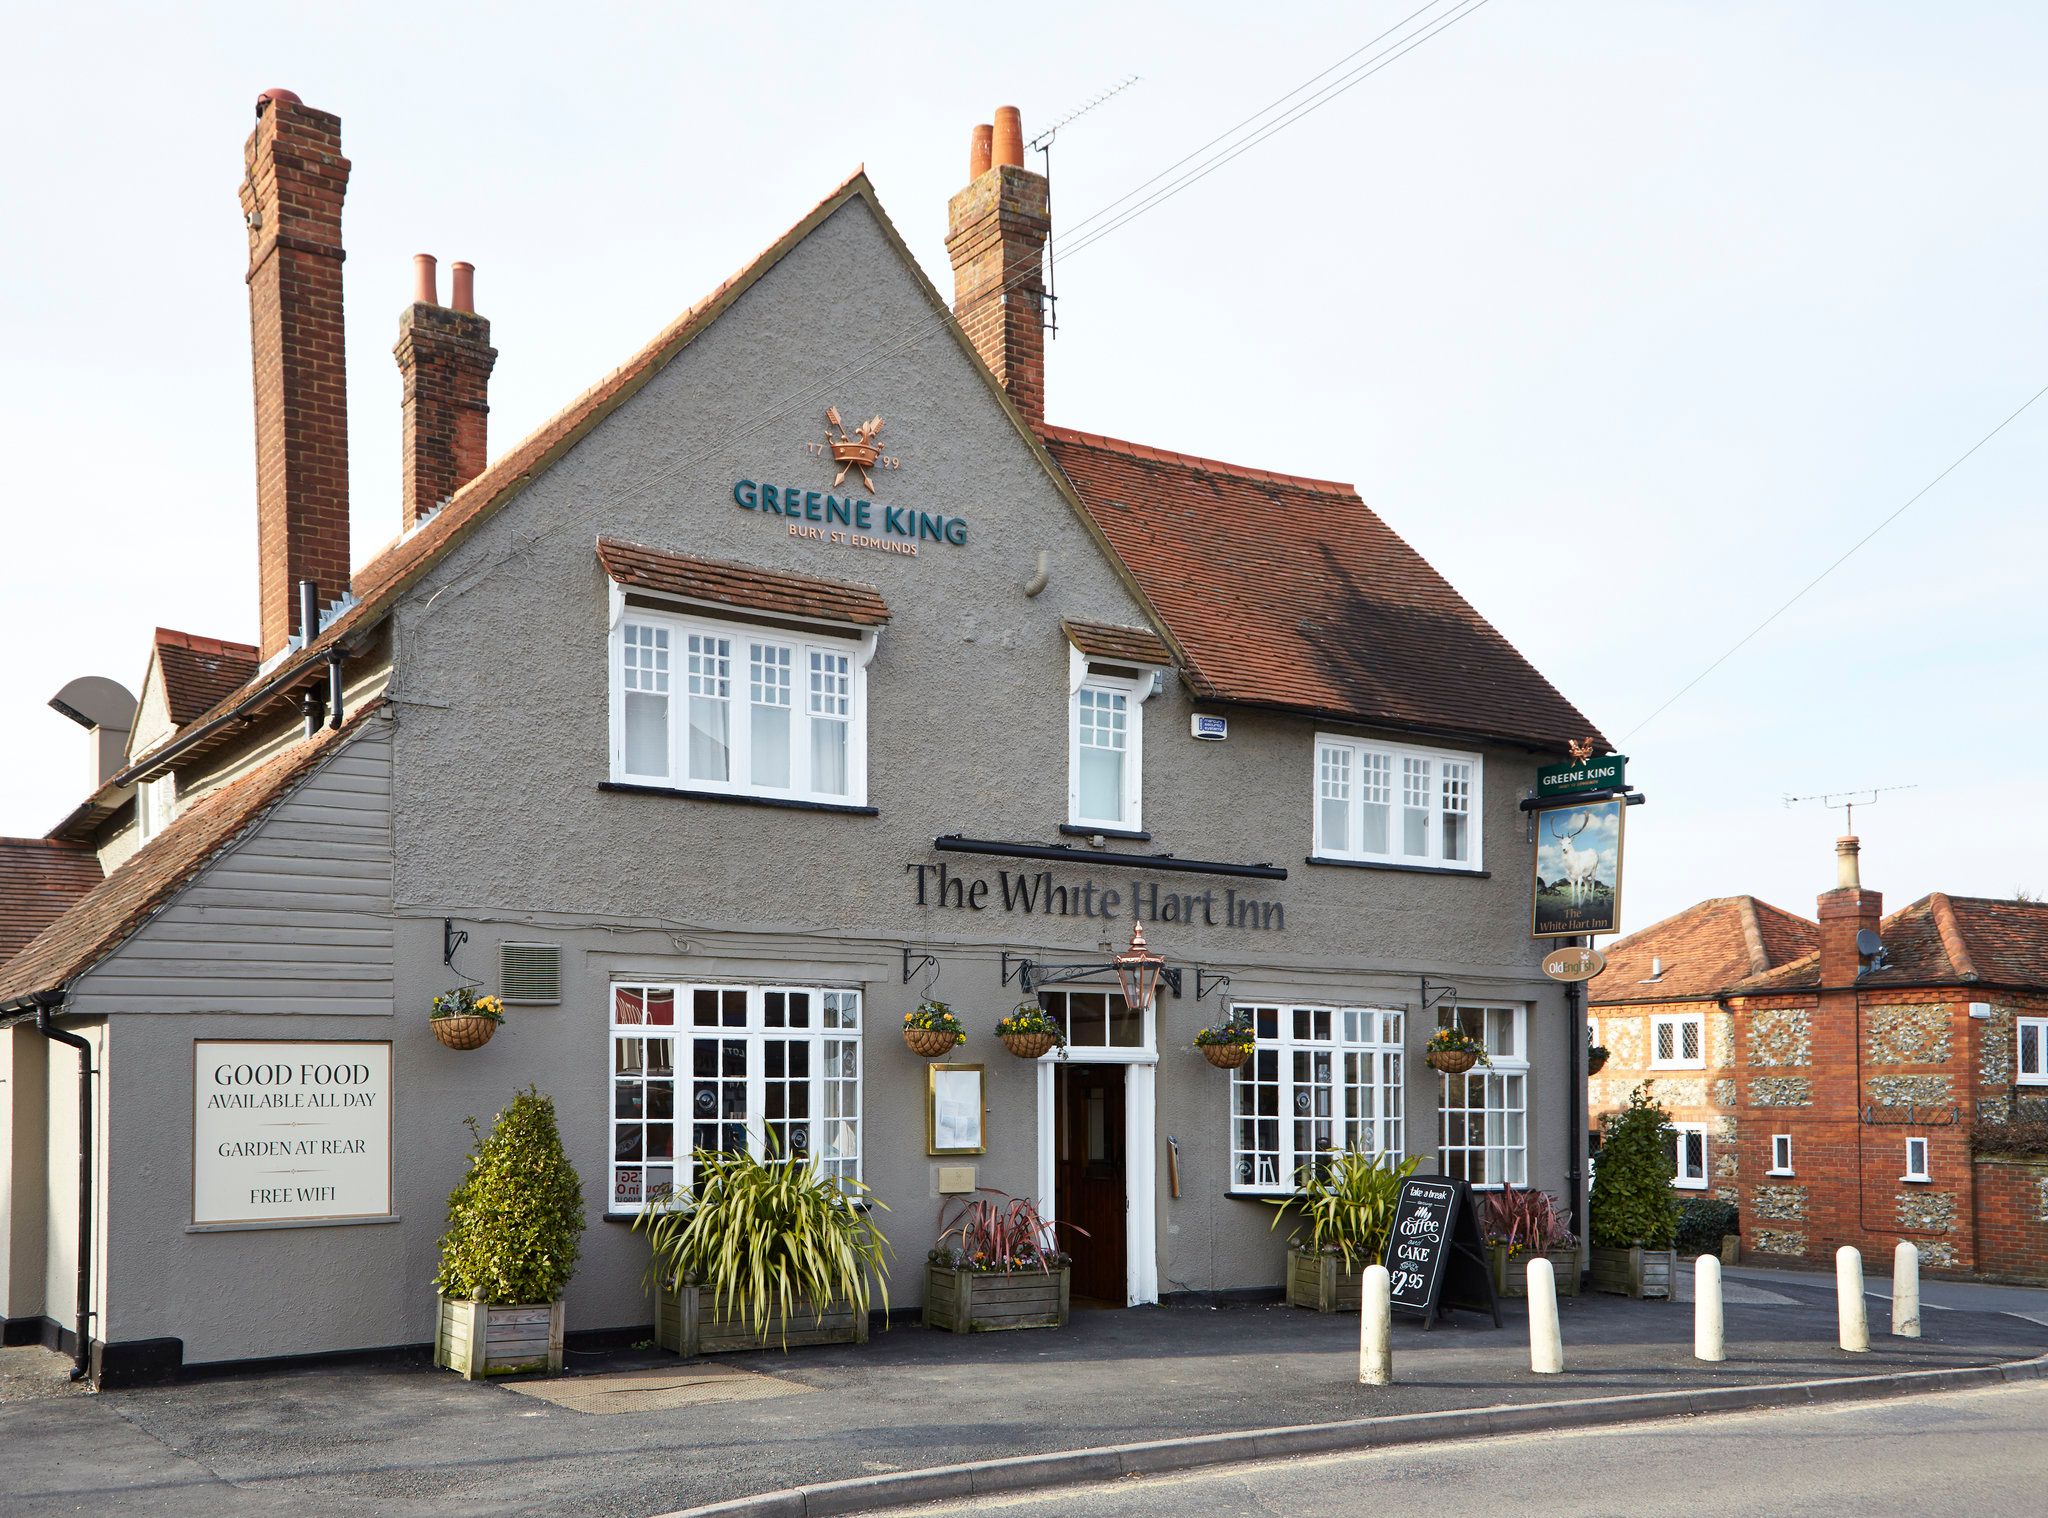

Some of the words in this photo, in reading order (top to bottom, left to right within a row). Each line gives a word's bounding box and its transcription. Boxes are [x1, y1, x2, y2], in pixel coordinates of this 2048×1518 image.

[883, 456, 900, 470] 99
[734, 479, 871, 528] GREENE
[886, 505, 967, 545] KING
[789, 523, 825, 540] BURY
[831, 531, 846, 543] ST
[852, 535, 918, 556] EDMUNDS
[1543, 771, 1584, 786] GREENE
[1587, 766, 1616, 779] KING
[906, 862, 989, 910] The
[999, 870, 1121, 919] White
[1129, 880, 1218, 926] Hart
[1225, 888, 1286, 930] Inn
[1564, 908, 1582, 919] The
[1539, 919, 1568, 931] White
[1569, 916, 1591, 930] Hart
[1592, 915, 1608, 928] Inn
[214, 1064, 293, 1086] GOOD
[301, 1064, 370, 1085] FOOD
[207, 1093, 304, 1109] AVAILABLE
[307, 1093, 339, 1108] ALL
[343, 1092, 376, 1107] DAY
[218, 1141, 291, 1157] GARDEN
[295, 1140, 318, 1155] AT
[321, 1139, 366, 1154] REAR
[250, 1188, 293, 1204] FREE
[297, 1187, 335, 1202] WIFI
[1410, 1186, 1423, 1198] take
[1428, 1190, 1447, 1200] break
[1414, 1206, 1432, 1220] illy
[1398, 1244, 1430, 1262] CAKE
[1390, 1270, 1424, 1296] £2.95
